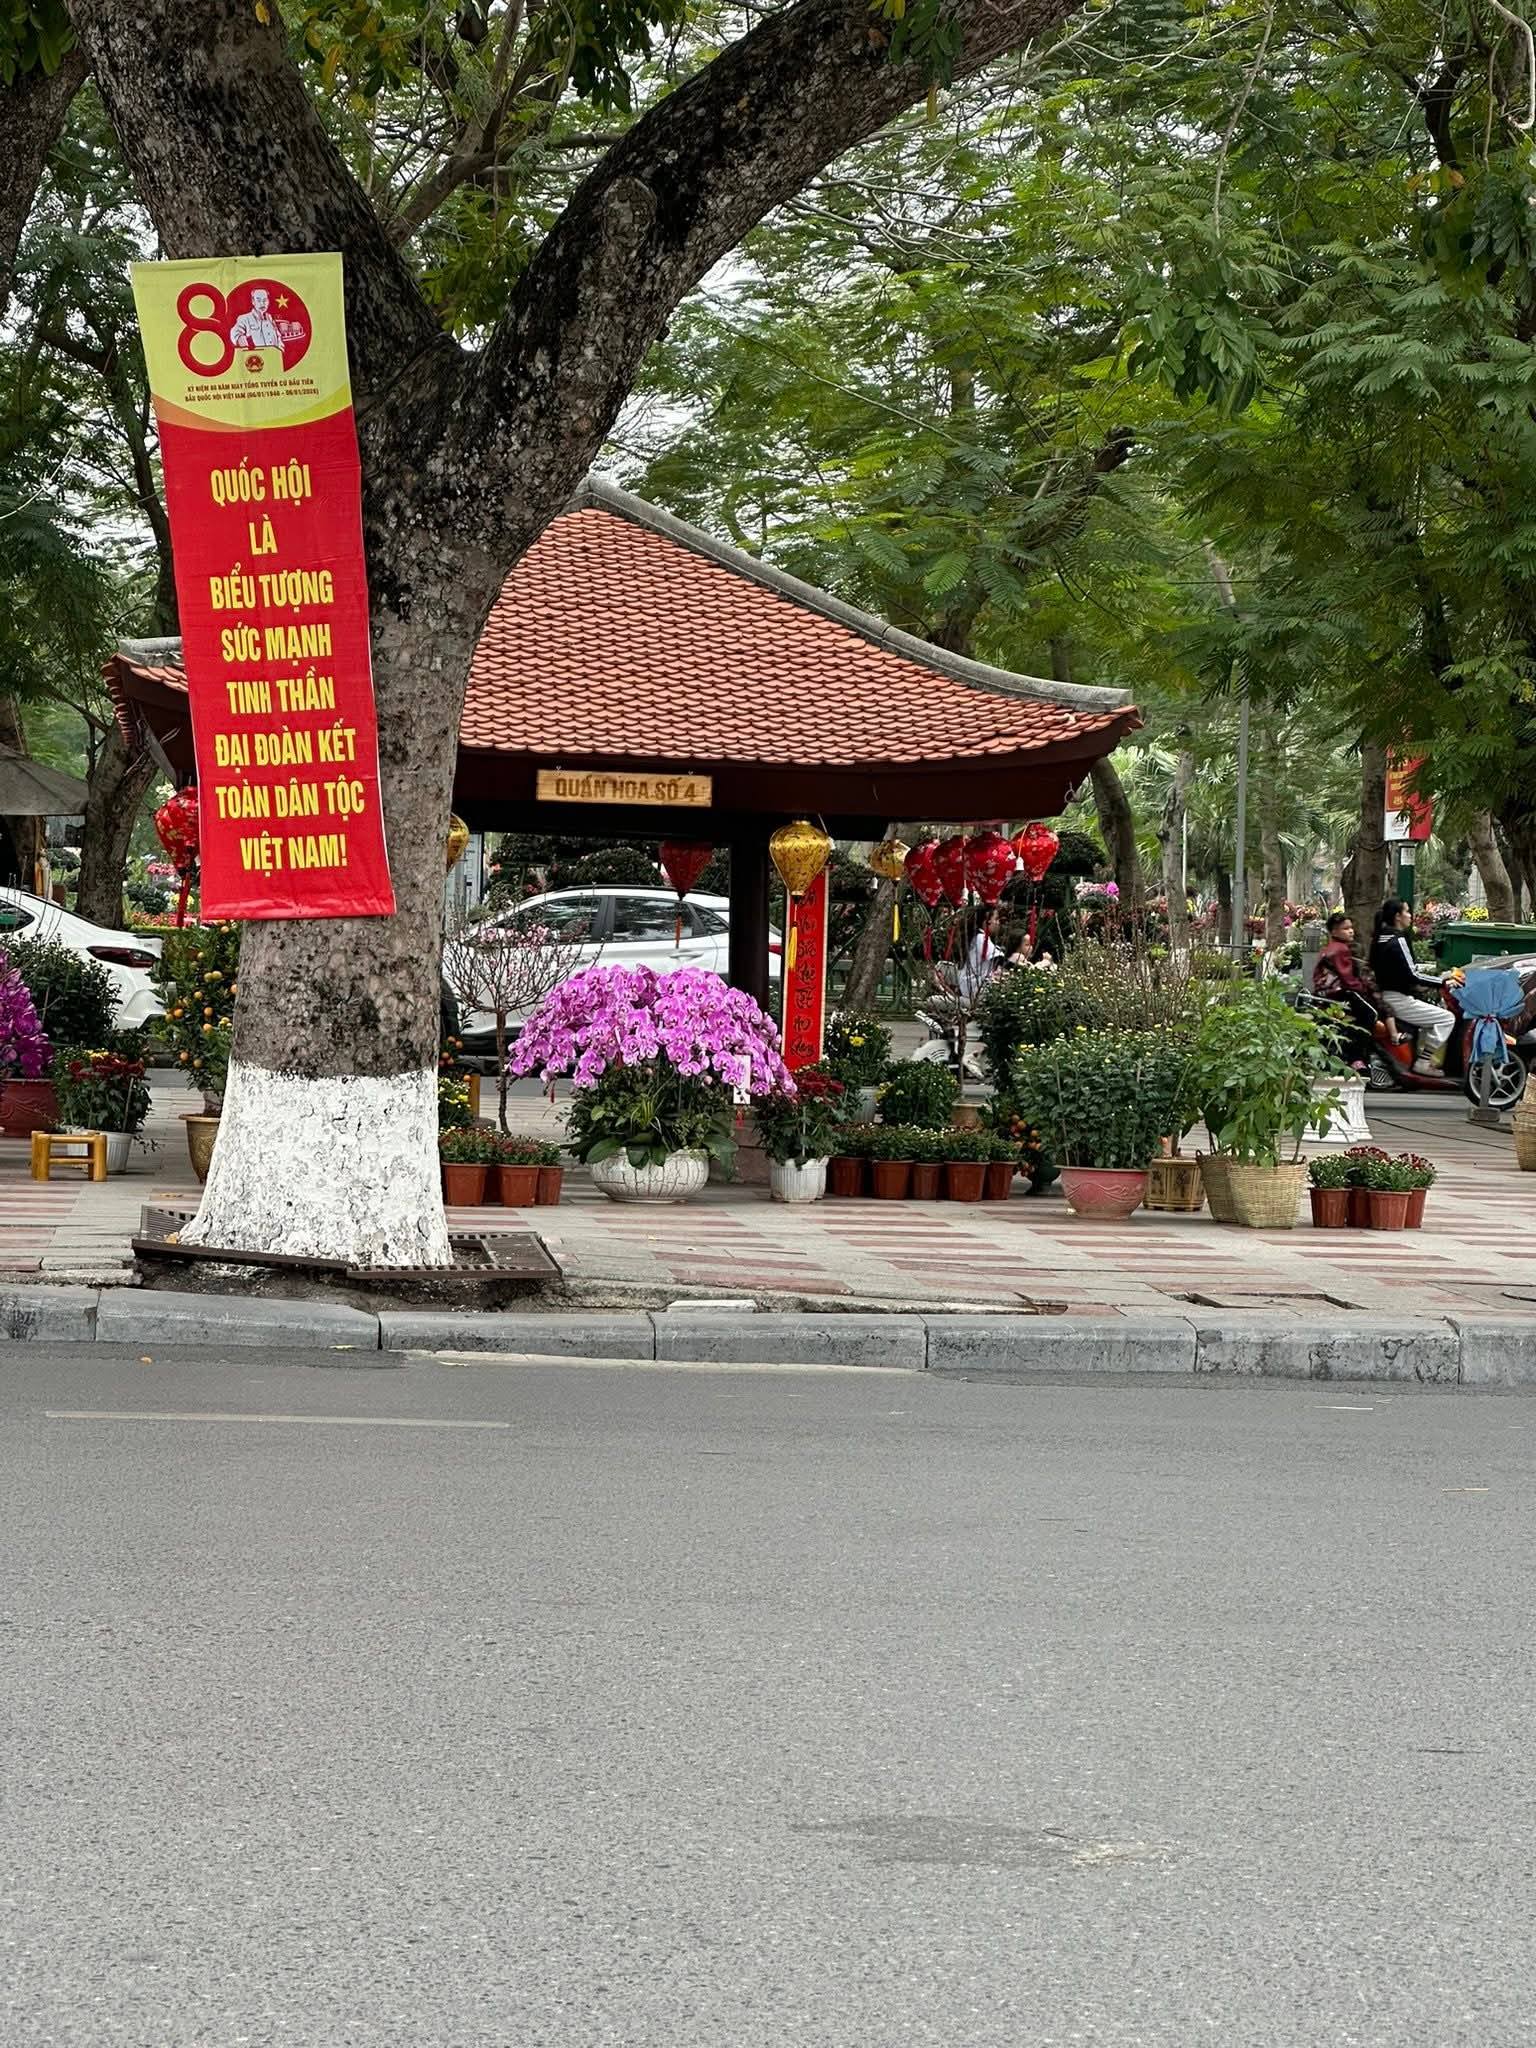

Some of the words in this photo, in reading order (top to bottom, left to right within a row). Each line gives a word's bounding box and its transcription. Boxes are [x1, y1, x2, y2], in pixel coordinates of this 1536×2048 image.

[177, 278, 312, 377] 80
[210, 456, 265, 507] QUỐC
[271, 458, 312, 506] HỘI
[249, 513, 278, 555] LÀ
[209, 562, 256, 609] BIỂU
[259, 569, 334, 613] TƯỢNG
[221, 622, 261, 663] SỨC
[264, 623, 332, 666] MẠNH
[226, 681, 272, 714] TINH
[276, 666, 336, 712] THẦN
[215, 733, 250, 774] ĐẠI
[254, 725, 313, 766] ĐOÀN
[317, 718, 356, 762] KẾT
[215, 778, 270, 819] TOÀN
[274, 777, 320, 818] DÂN
[324, 774, 365, 821] TỘC
[555, 775, 607, 798] QUÁN
[612, 780, 649, 800] HOA
[655, 776, 683, 802] SỐ
[684, 783, 697, 803] 4
[240, 830, 283, 877] VIỆT
[288, 833, 348, 869] NAM!
